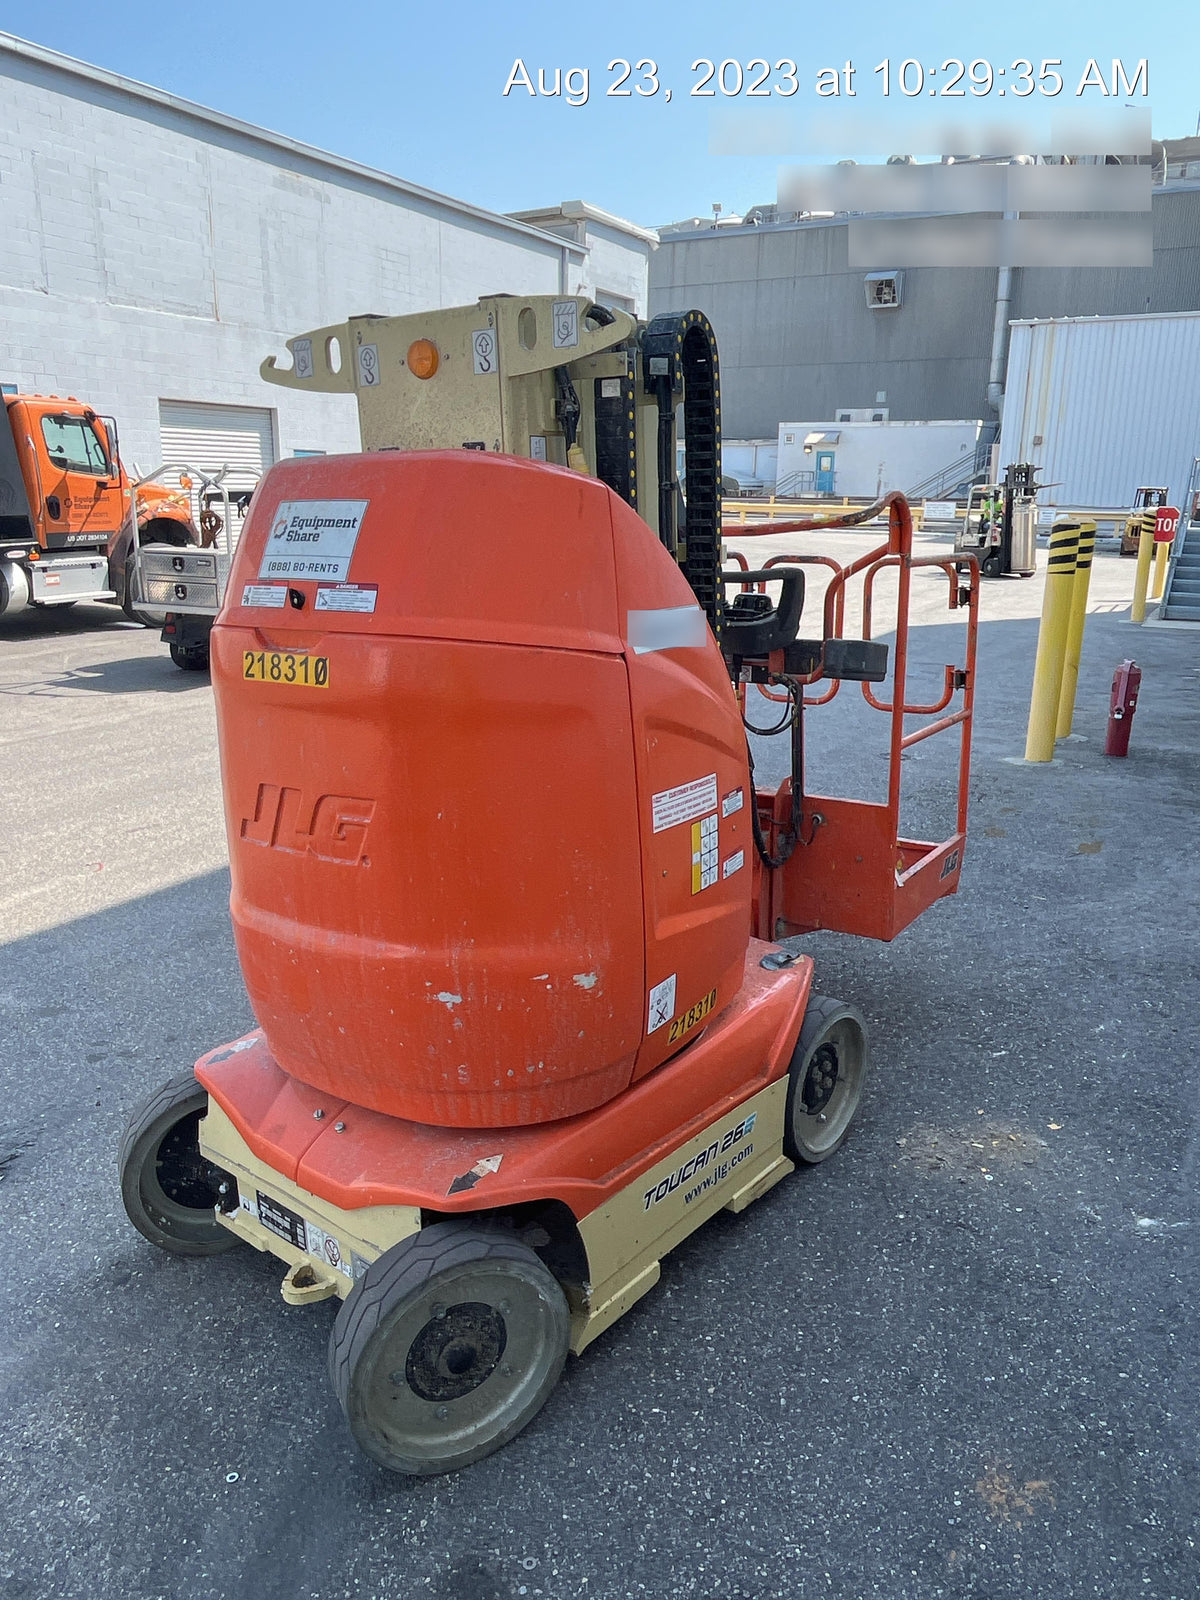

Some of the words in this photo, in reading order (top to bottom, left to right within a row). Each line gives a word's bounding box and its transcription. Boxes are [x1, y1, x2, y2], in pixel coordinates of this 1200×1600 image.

[286, 530, 320, 542] Share
[290, 516, 358, 530] Equipment
[268, 561, 291, 573] (888)
[244, 652, 328, 686] 218310
[240, 783, 378, 867] JLG
[669, 988, 717, 1043] 218310
[643, 1140, 720, 1211] TOUCAN
[684, 1143, 754, 1204] www.jlg.com
